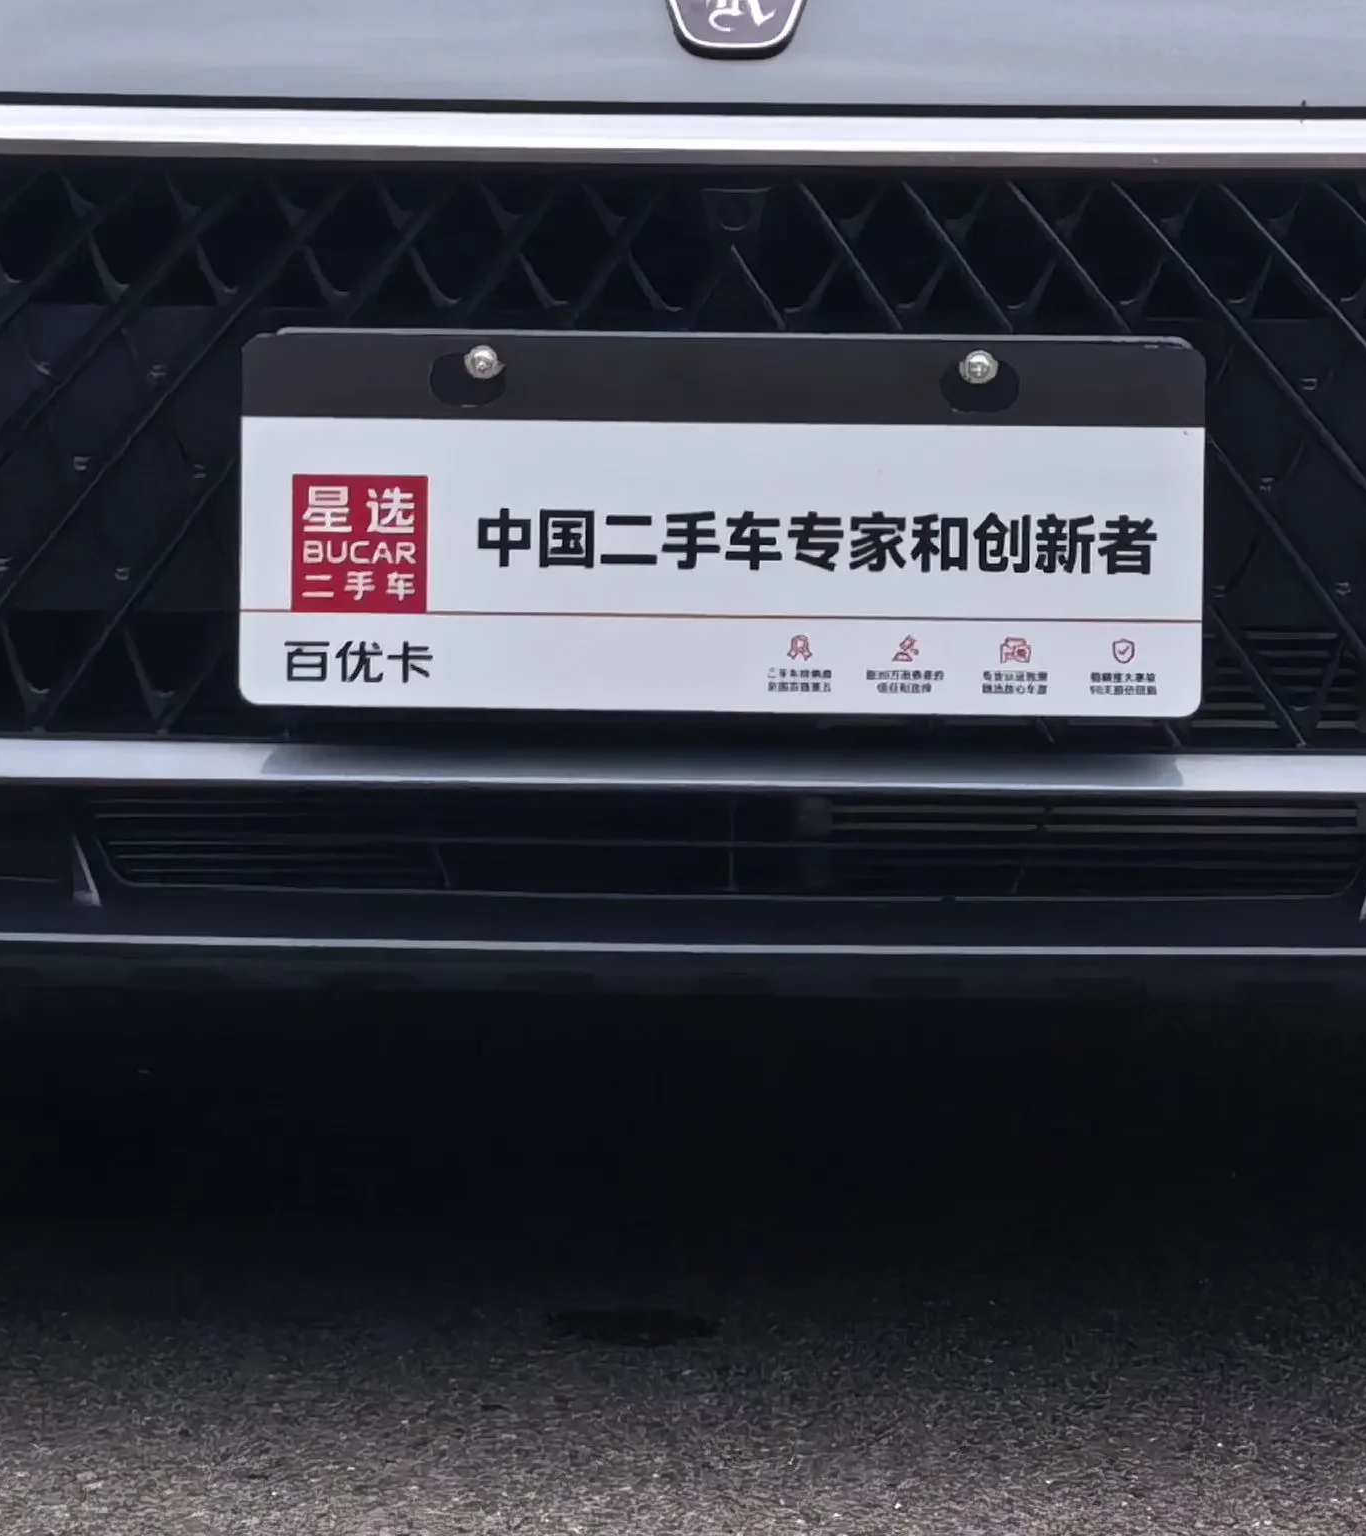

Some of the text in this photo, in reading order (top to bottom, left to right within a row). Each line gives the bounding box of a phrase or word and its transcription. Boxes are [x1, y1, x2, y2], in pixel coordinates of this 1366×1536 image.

[302, 485, 416, 534] 星选
[302, 540, 417, 565] BUCAR
[476, 507, 1158, 577] 中国二手车专家和创新者
[301, 570, 416, 602] 二手车
[284, 640, 434, 684] 百优卡
